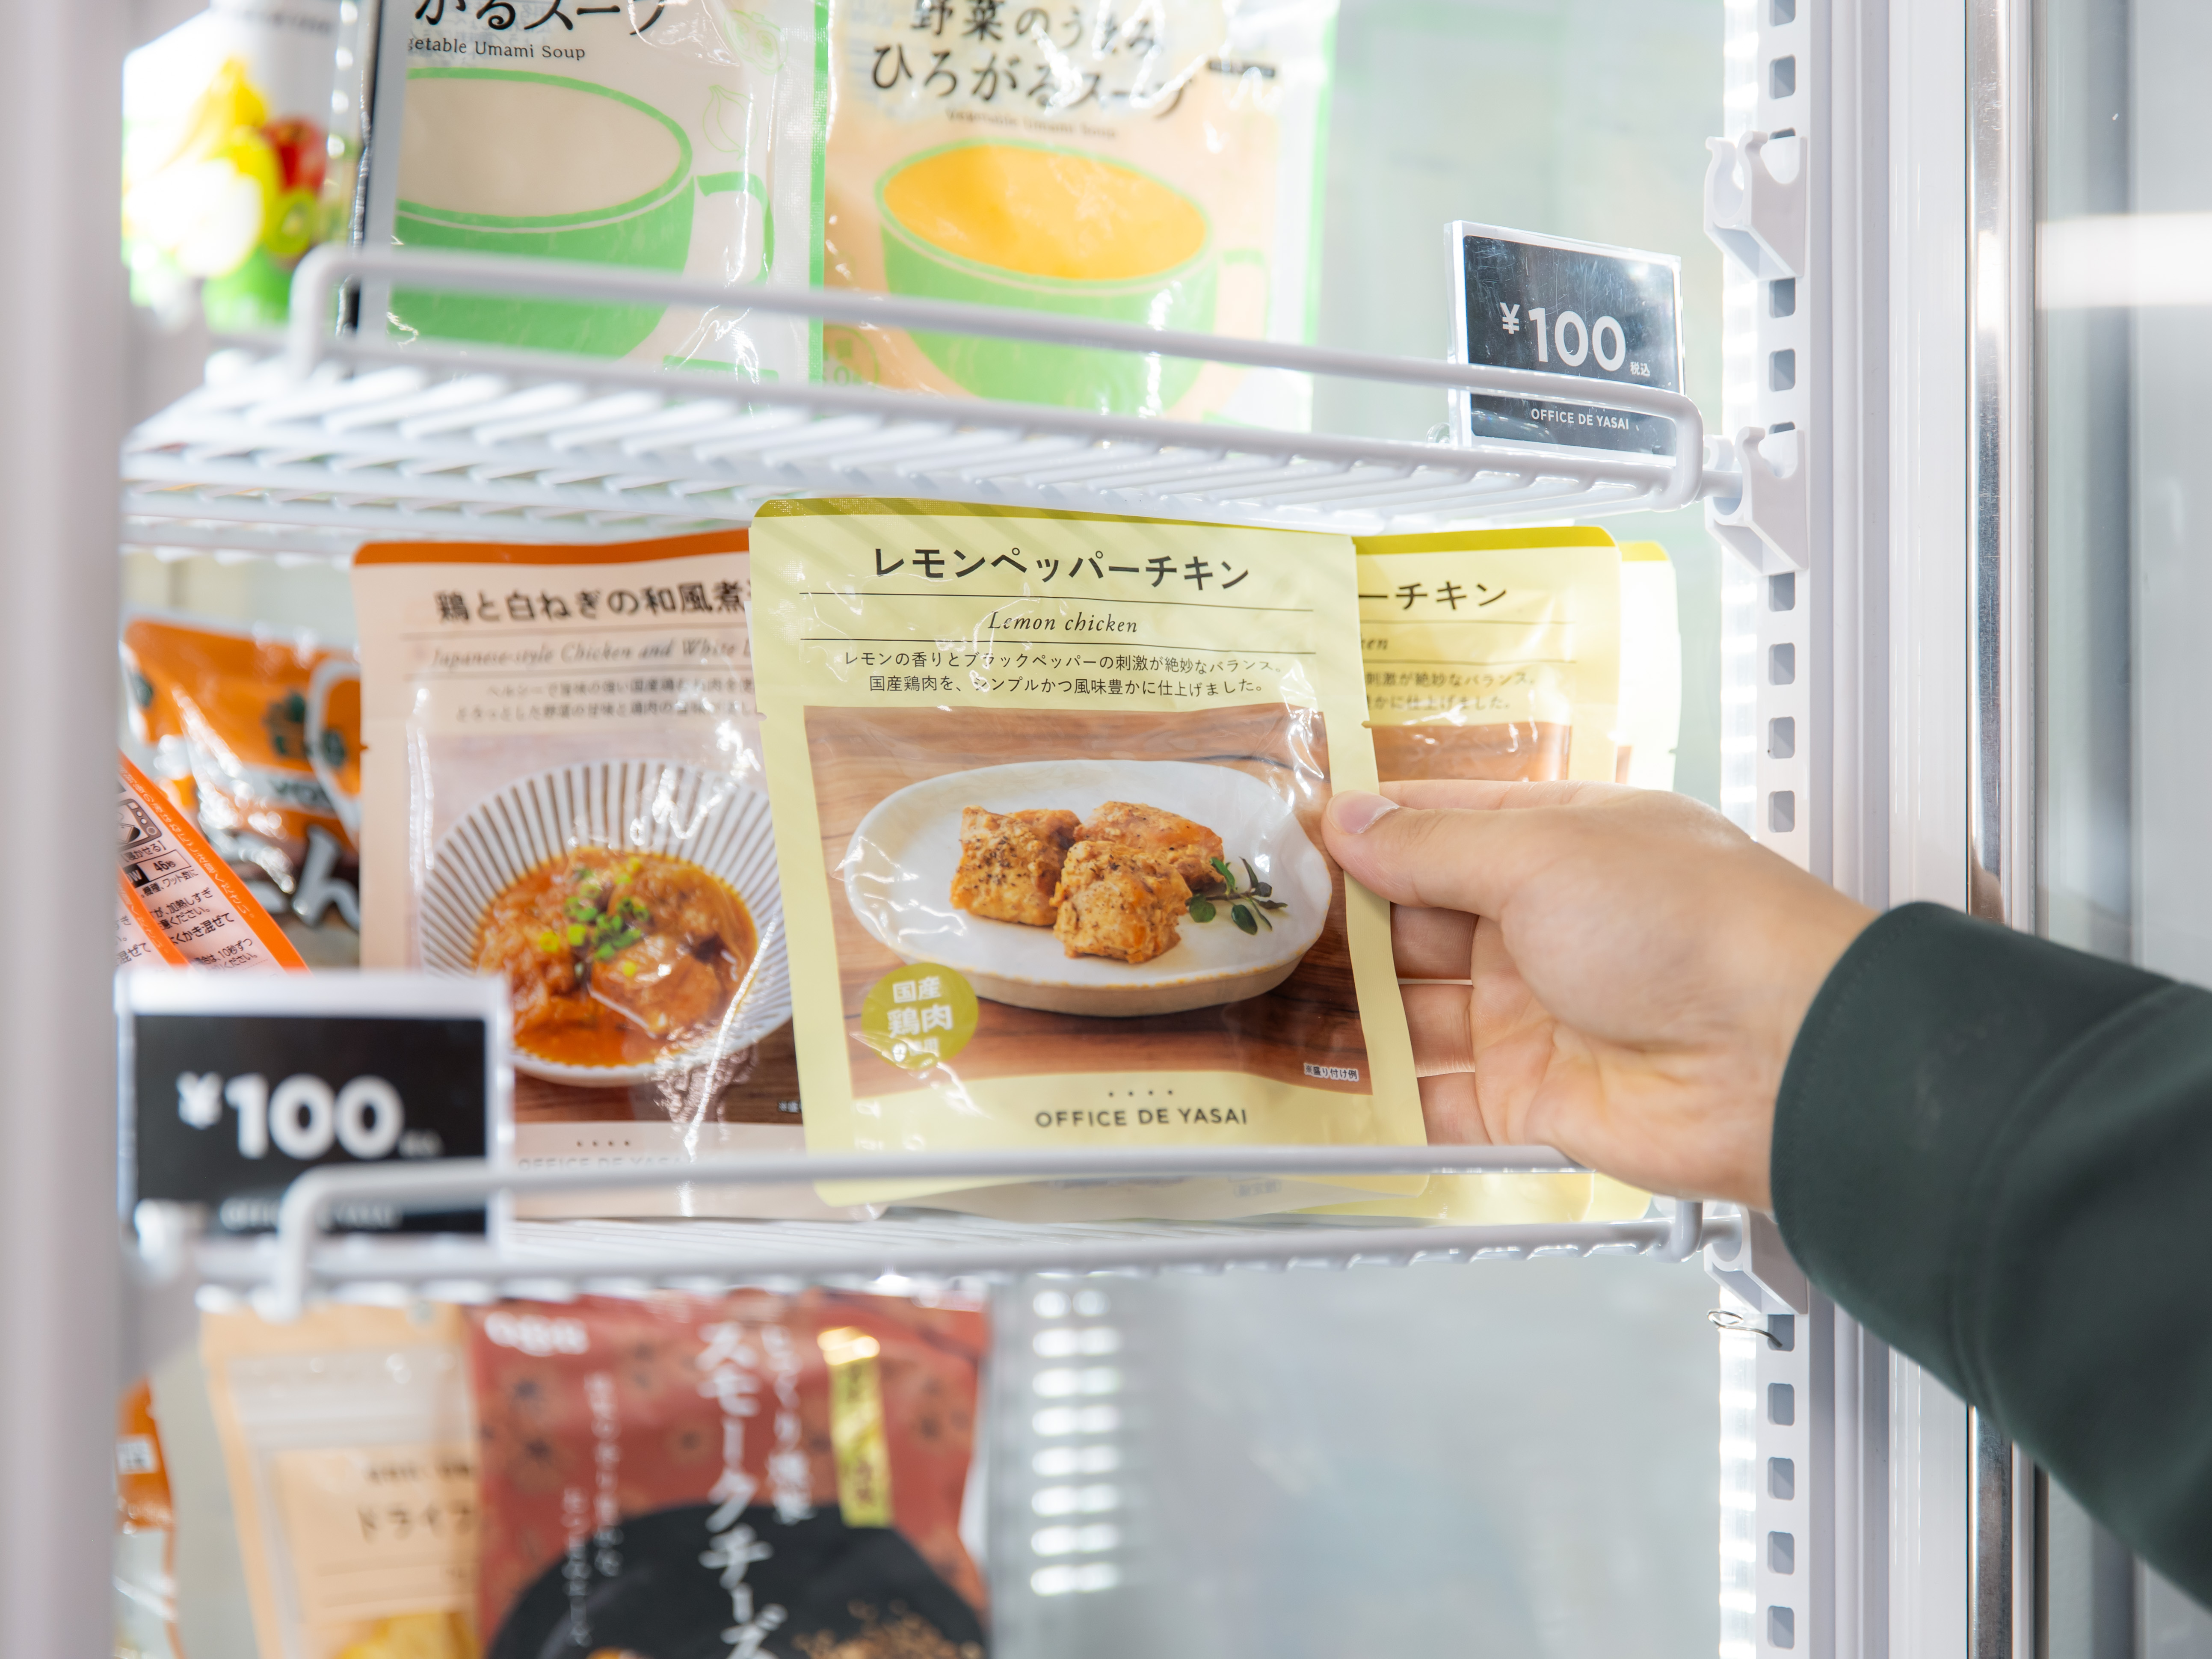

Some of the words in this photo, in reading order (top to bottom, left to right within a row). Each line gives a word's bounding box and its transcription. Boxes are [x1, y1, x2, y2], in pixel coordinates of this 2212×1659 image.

[475, 41, 534, 58] Umami
[542, 45, 585, 61] Soup
[1500, 302, 1626, 371] ¥100
[1630, 361, 1650, 376] 税込
[1531, 408, 1574, 424] OFFICE
[1578, 413, 1593, 426] DE
[1596, 415, 1629, 430] YASAI
[875, 548, 1249, 590] レモンペッパーチキン
[435, 578, 751, 623] 鶏と白ねぎの和風煮
[988, 611, 1055, 630] Lemon
[1065, 612, 1137, 633] chicken
[561, 640, 631, 663] Chicken
[637, 639, 672, 659] and
[846, 651, 1280, 674] レモンの香りとブラックペッパーの刺激が絶妙なバランス。
[870, 675, 1261, 697] 国産鶏肉を、シンプルかつ風味豊かに仕上げました。
[1368, 693, 1510, 711] かに仕上げました。
[150, 887, 213, 918] が、加熱しすぎ
[194, 938, 253, 965] 合は、10秒ずつ
[892, 975, 942, 1004] 国産
[887, 1004, 953, 1039] 鶏肉
[176, 1071, 404, 1160] ¥100
[1035, 1111, 1128, 1128] OFFICE
[1137, 1109, 1169, 1125] DE
[1177, 1108, 1247, 1125] YASAI
